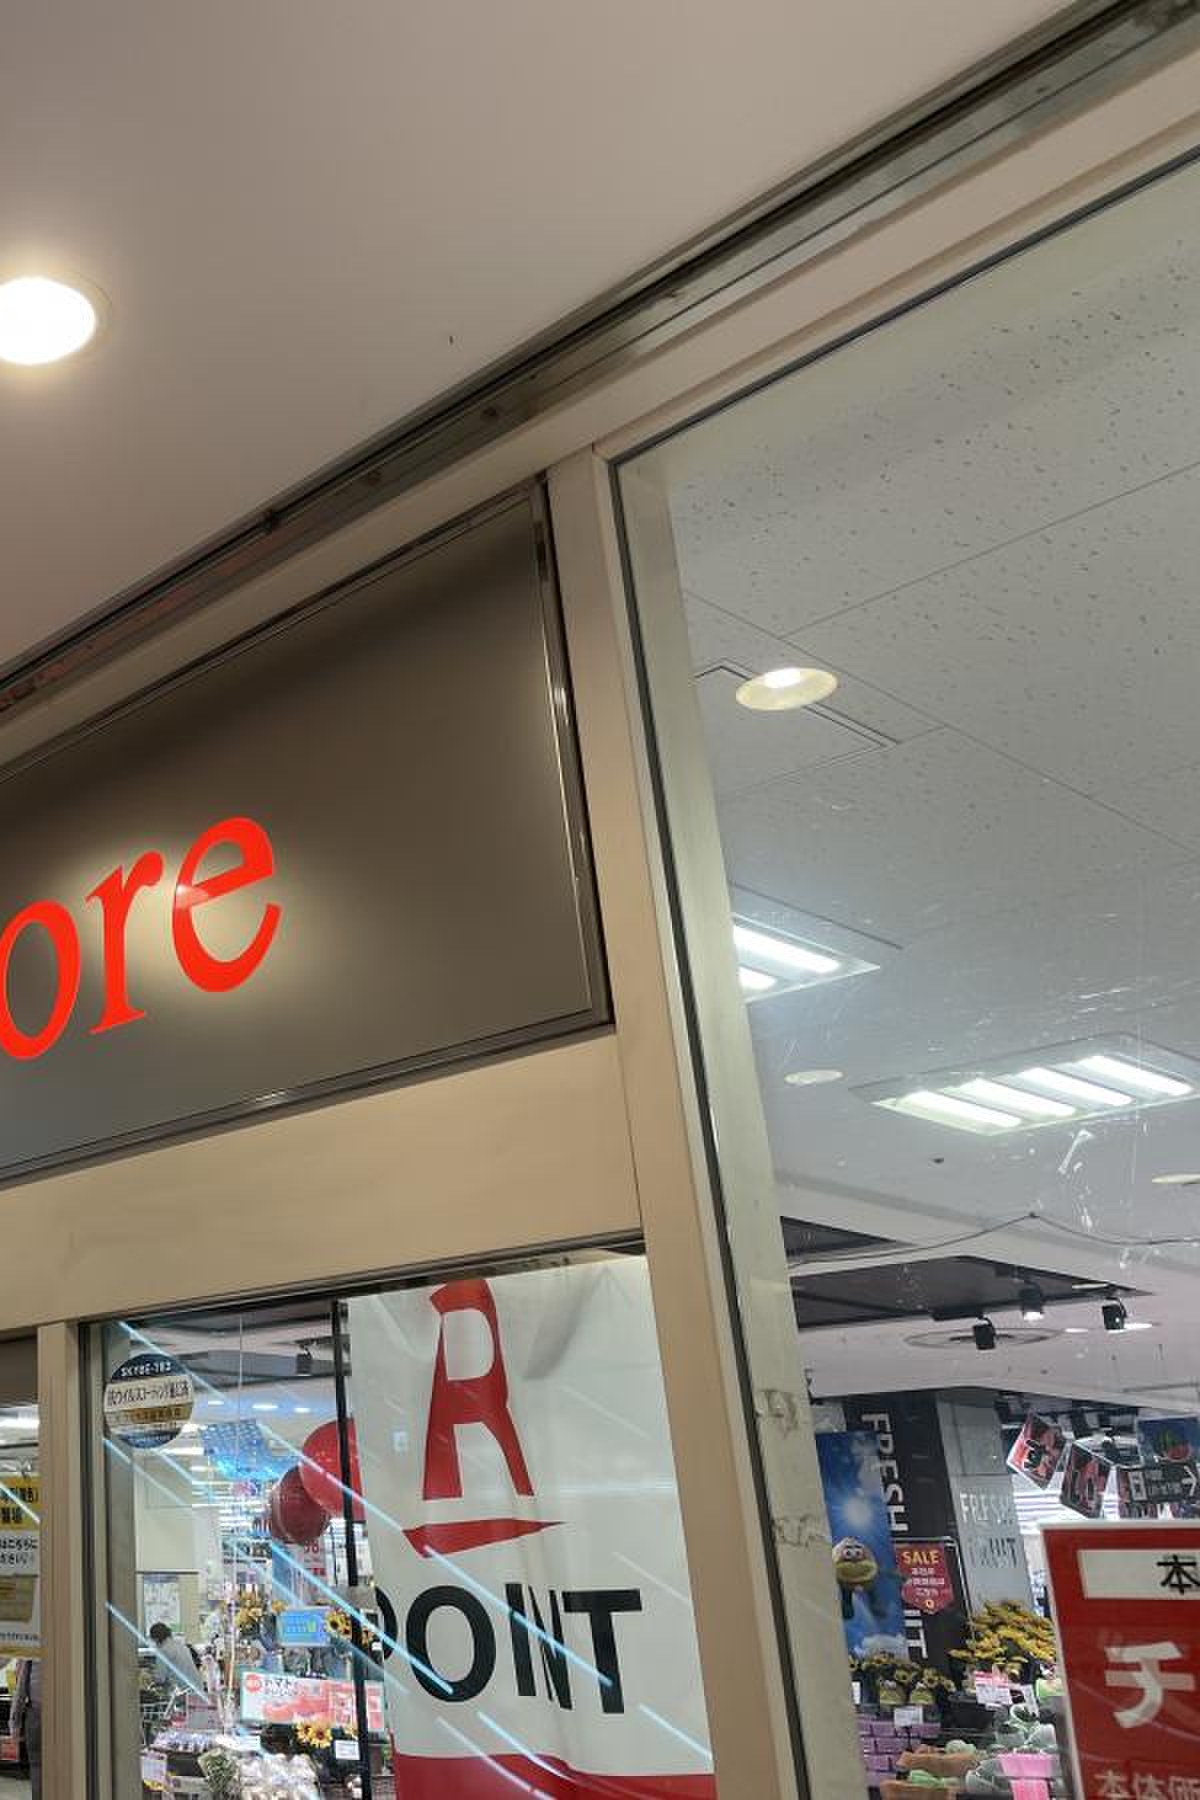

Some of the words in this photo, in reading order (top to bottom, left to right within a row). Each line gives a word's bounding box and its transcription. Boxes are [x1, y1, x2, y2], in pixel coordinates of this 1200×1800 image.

[421, 1277, 535, 1500] R
[901, 1549, 940, 1566] SALE
[1103, 1641, 1196, 1728] チ
